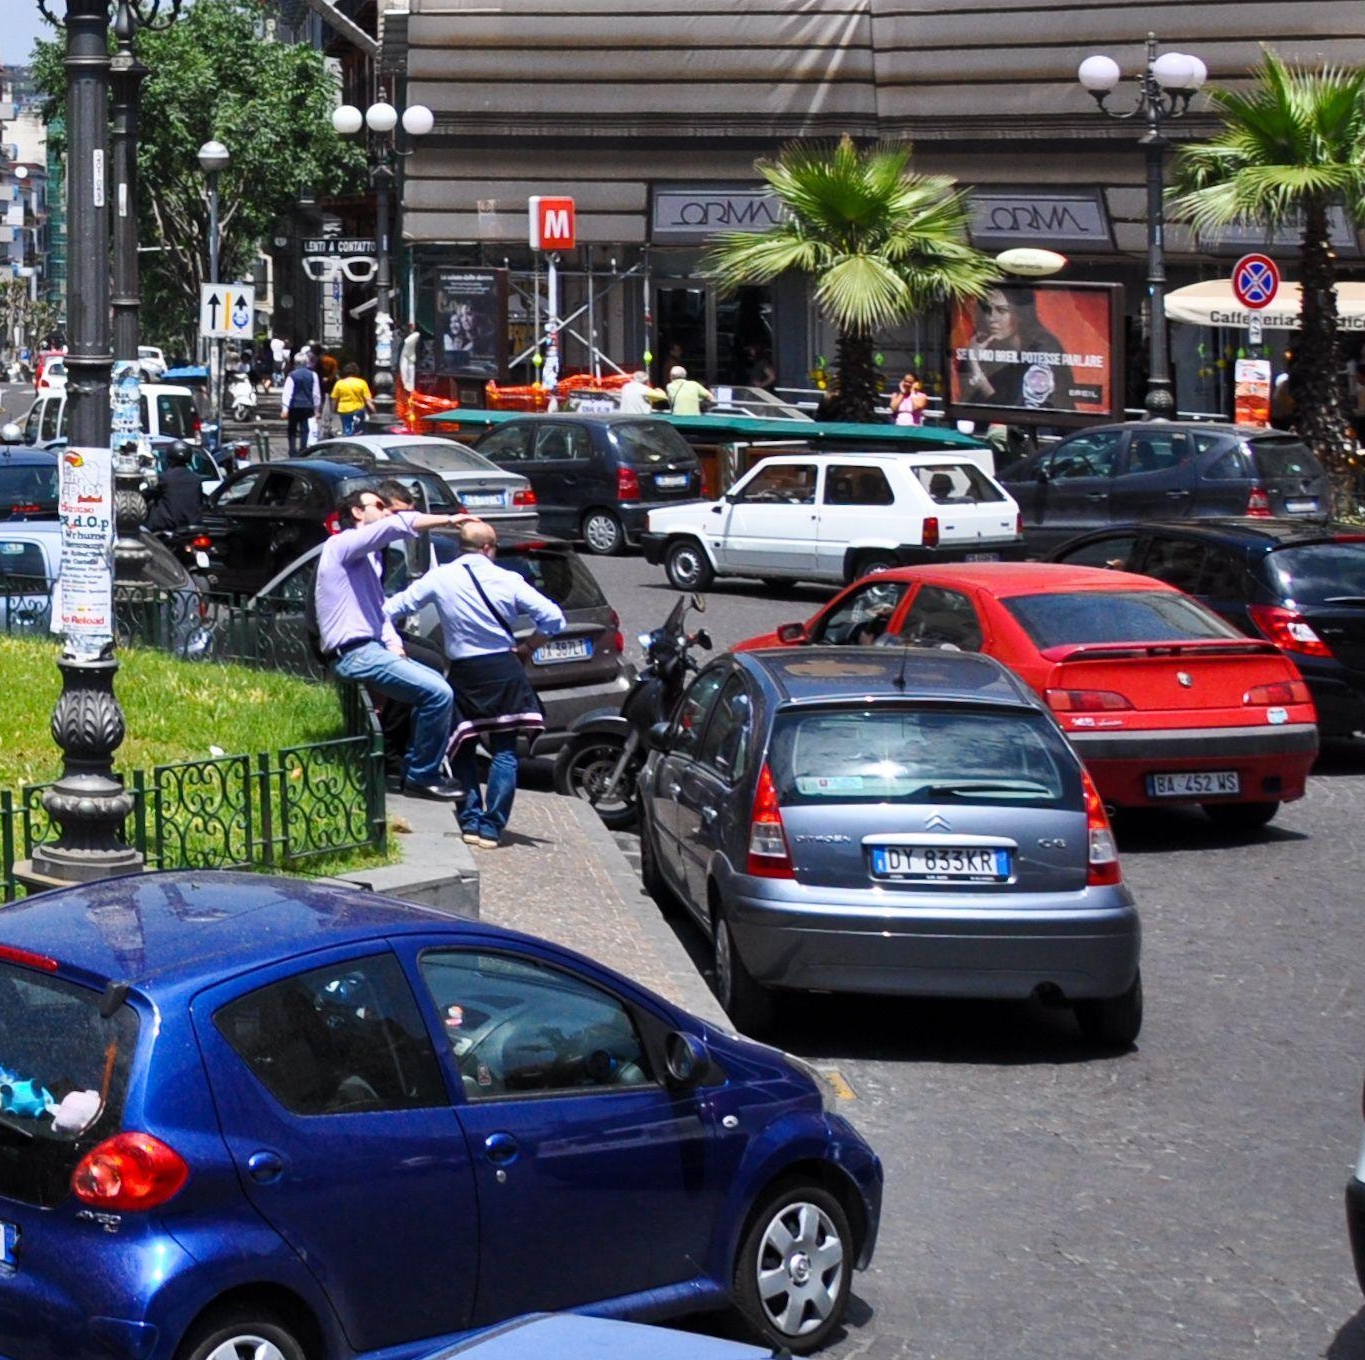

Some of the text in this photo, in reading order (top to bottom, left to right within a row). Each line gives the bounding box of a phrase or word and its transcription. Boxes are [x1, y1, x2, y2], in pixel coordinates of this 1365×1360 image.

[543, 209, 570, 239] M
[304, 241, 326, 253] LENTI
[337, 241, 376, 253] CONTATTO
[1020, 351, 1061, 366] POTESSE
[1156, 773, 1237, 793] BA 452 WS
[889, 848, 993, 872] DY 833KR
